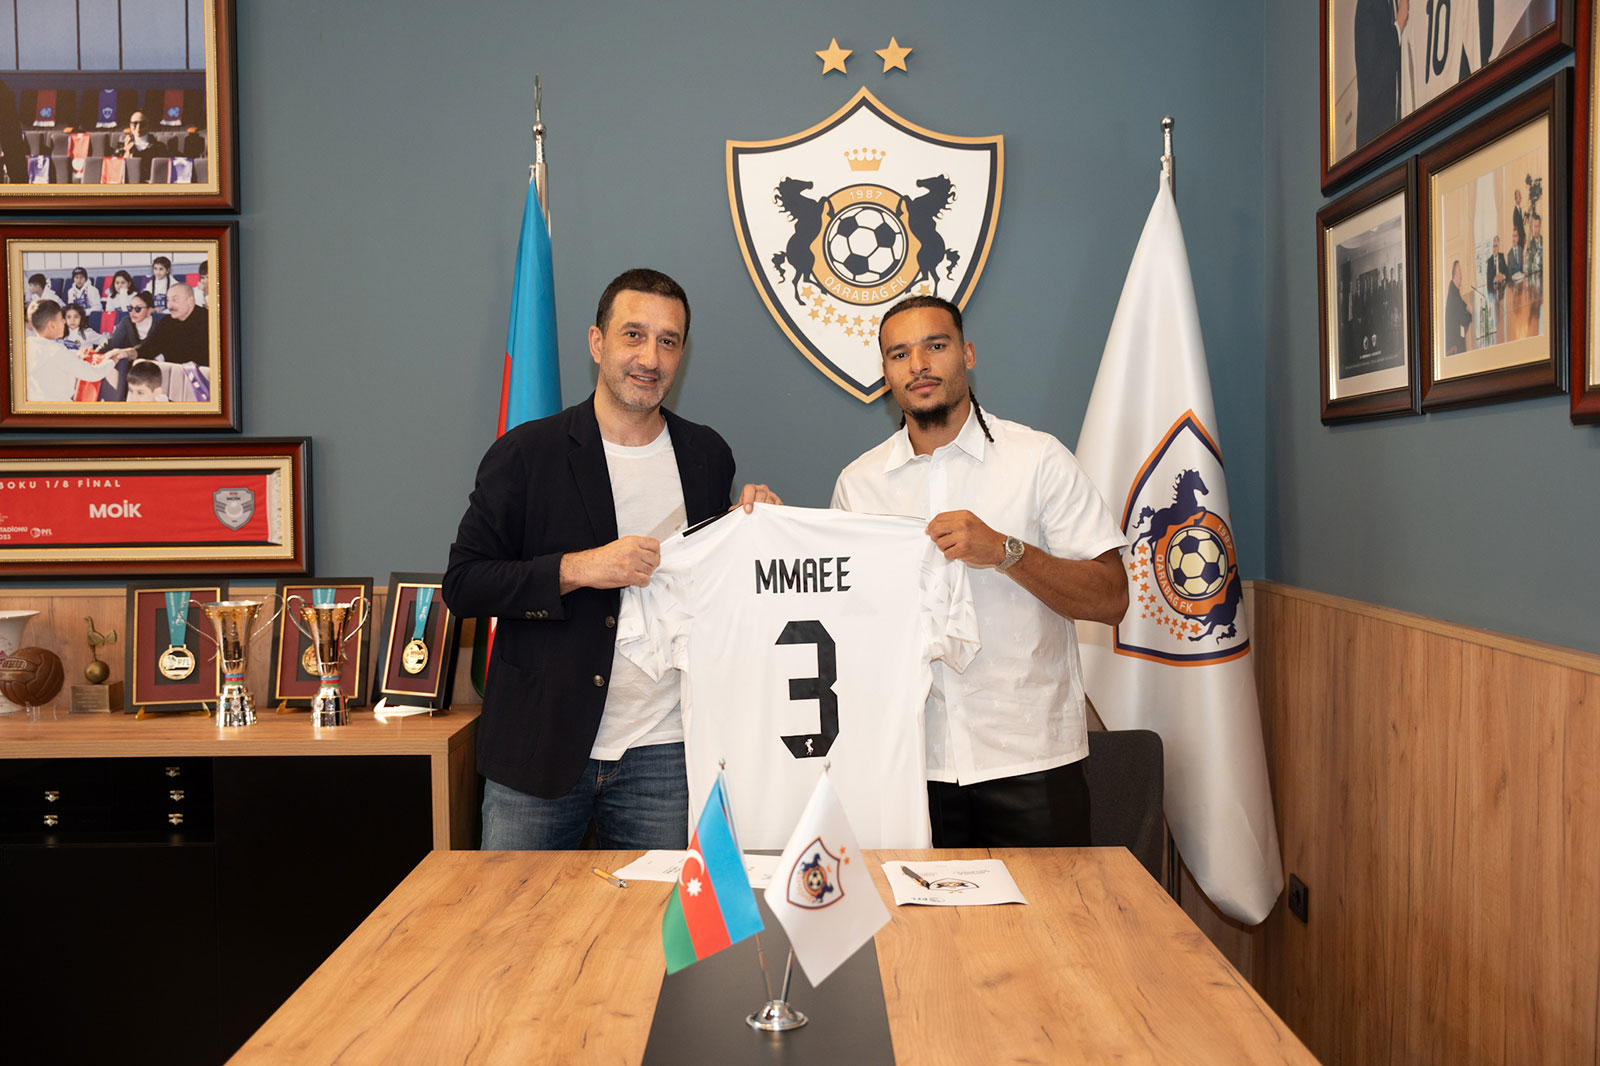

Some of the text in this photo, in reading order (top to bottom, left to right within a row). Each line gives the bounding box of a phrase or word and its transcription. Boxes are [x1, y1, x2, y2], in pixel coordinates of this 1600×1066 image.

[1426, 0, 1451, 85] 10
[849, 189, 883, 200] 1987
[889, 276, 907, 293] FK
[45, 480, 70, 489] 1/8
[78, 478, 121, 488] FİNAL
[89, 499, 143, 519] MOİK
[755, 556, 852, 594] MMAEE
[1179, 601, 1193, 613] FK
[775, 620, 840, 759] 3
